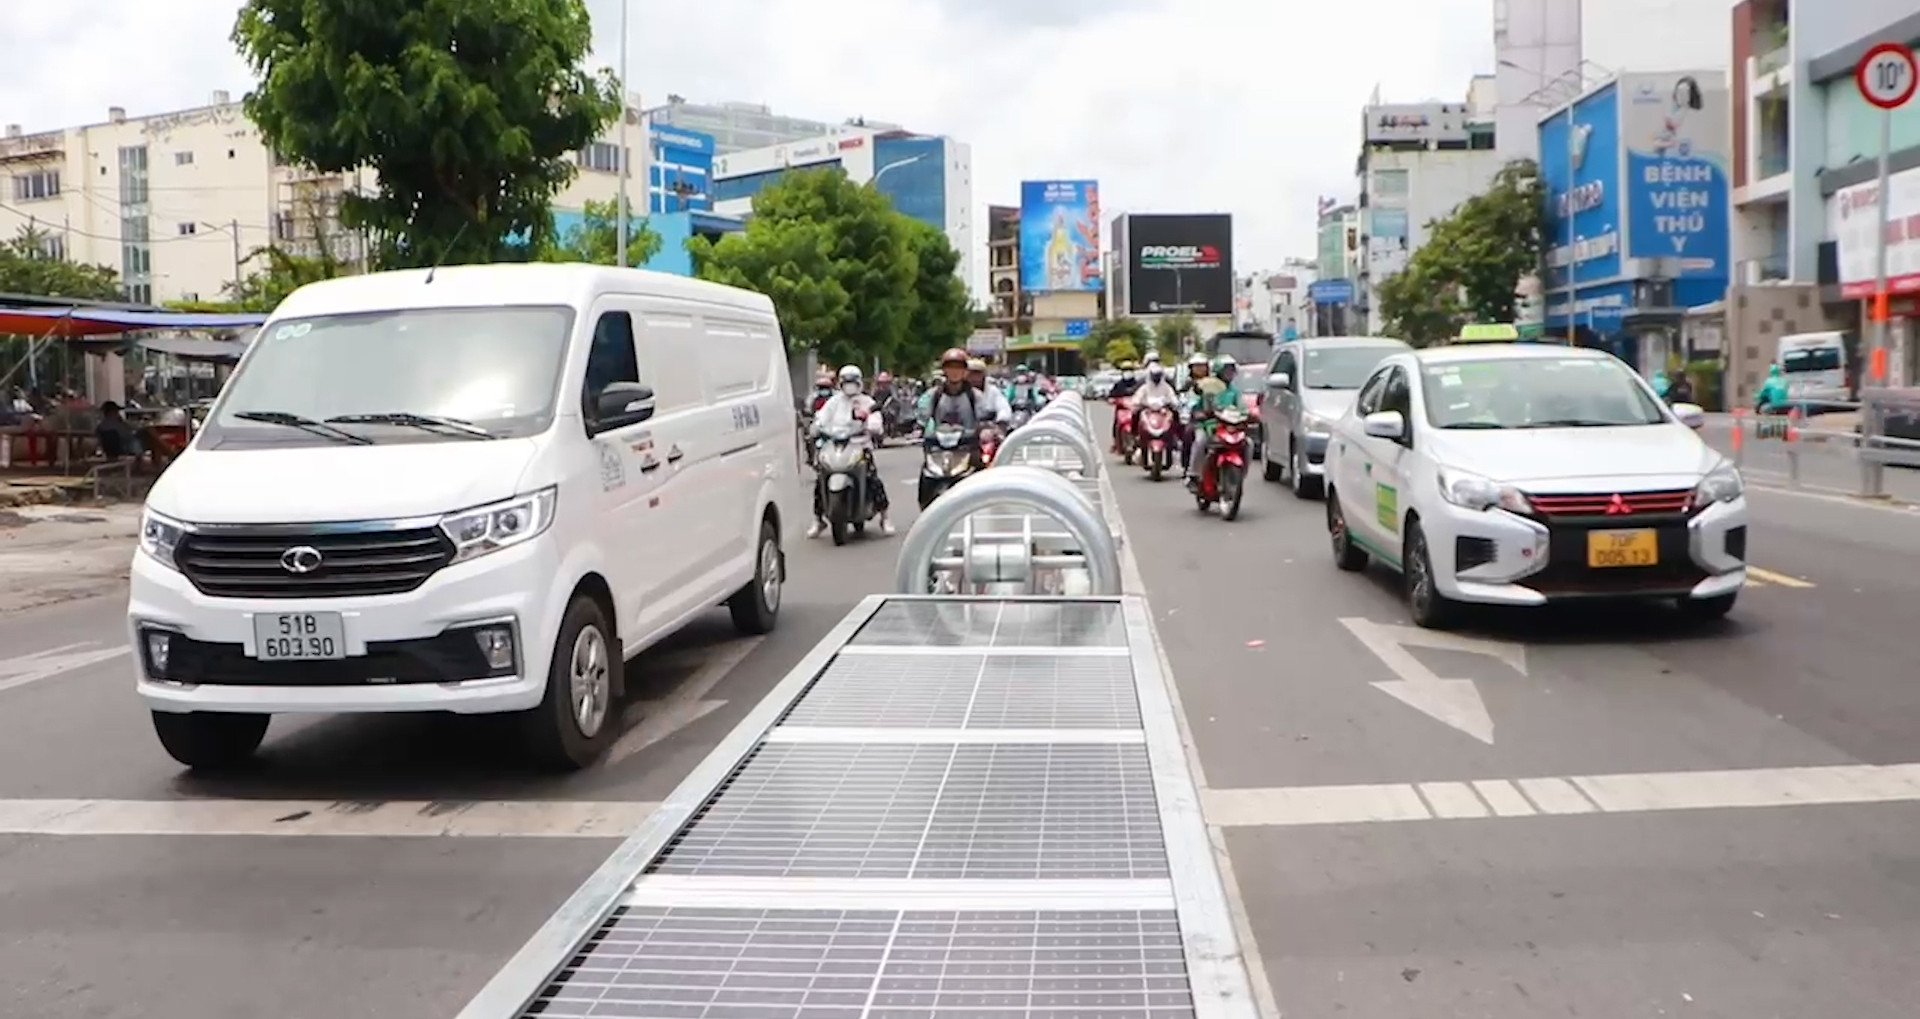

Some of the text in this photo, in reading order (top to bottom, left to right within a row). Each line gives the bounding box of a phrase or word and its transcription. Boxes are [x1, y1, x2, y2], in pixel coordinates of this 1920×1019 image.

[1644, 161, 1711, 187] BỆNH
[1650, 186, 1709, 213] VIỆN
[1141, 245, 1203, 257] PROEL
[1672, 236, 1687, 252] Y
[279, 615, 316, 634] 51B
[266, 637, 334, 656] 603.90
